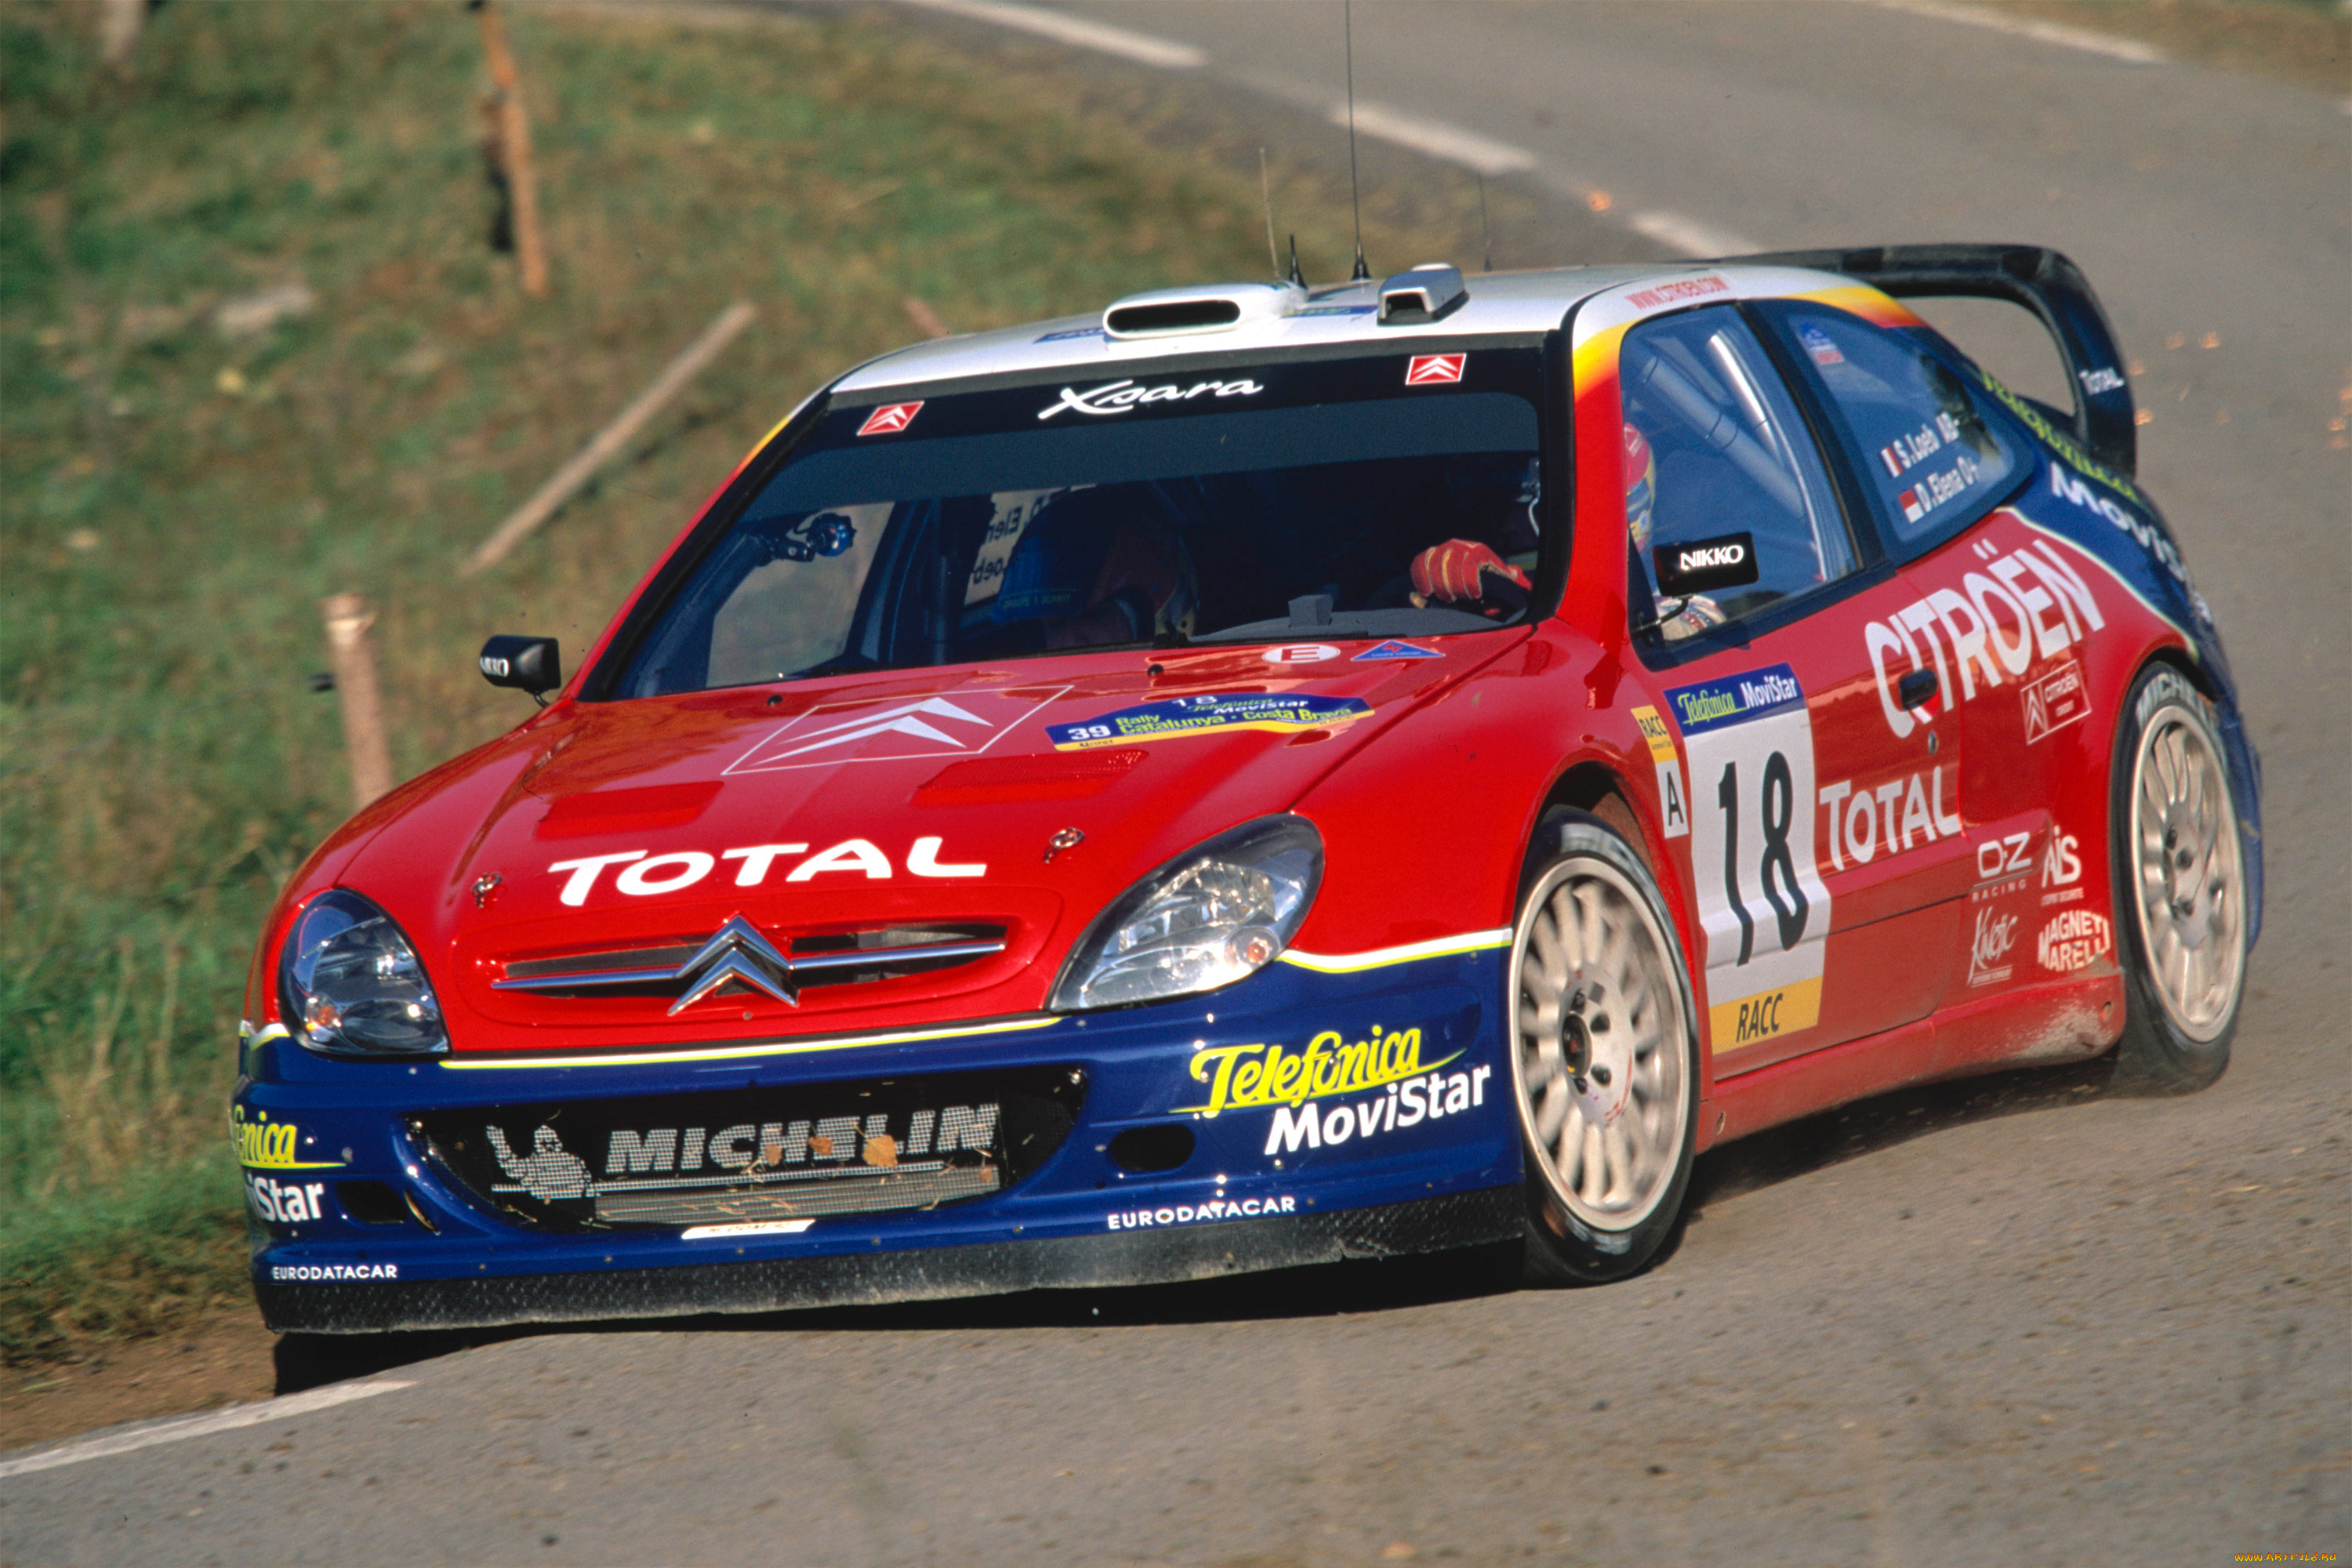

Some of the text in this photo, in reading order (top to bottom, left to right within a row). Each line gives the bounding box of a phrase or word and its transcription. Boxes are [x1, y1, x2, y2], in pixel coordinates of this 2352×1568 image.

[1039, 379, 1264, 419] Xsara
[1680, 545, 1744, 570] NIKKO
[1281, 646, 1320, 662] E
[1865, 539, 2105, 738] CITROËN
[1740, 675, 1798, 709] MoviStar
[1068, 725, 1111, 740] 39
[1115, 714, 1160, 727] Rally
[1119, 714, 1225, 733] Catalunya
[1243, 709, 1294, 720] Costa
[1298, 708, 1352, 722] Brava
[1639, 716, 1667, 739] RACC
[1667, 771, 1685, 826] A
[1819, 765, 1962, 872] TOTAL
[548, 837, 988, 907] TOTAL
[1719, 750, 1809, 967] 18
[1972, 879, 2027, 903] RACING
[1736, 992, 1784, 1043] RACC
[1264, 1065, 1491, 1156] MoviStar
[605, 1104, 1000, 1173] MICHELIN
[1107, 1196, 1295, 1230] EURODATACAR
[271, 1265, 397, 1279] EURODATACAR
